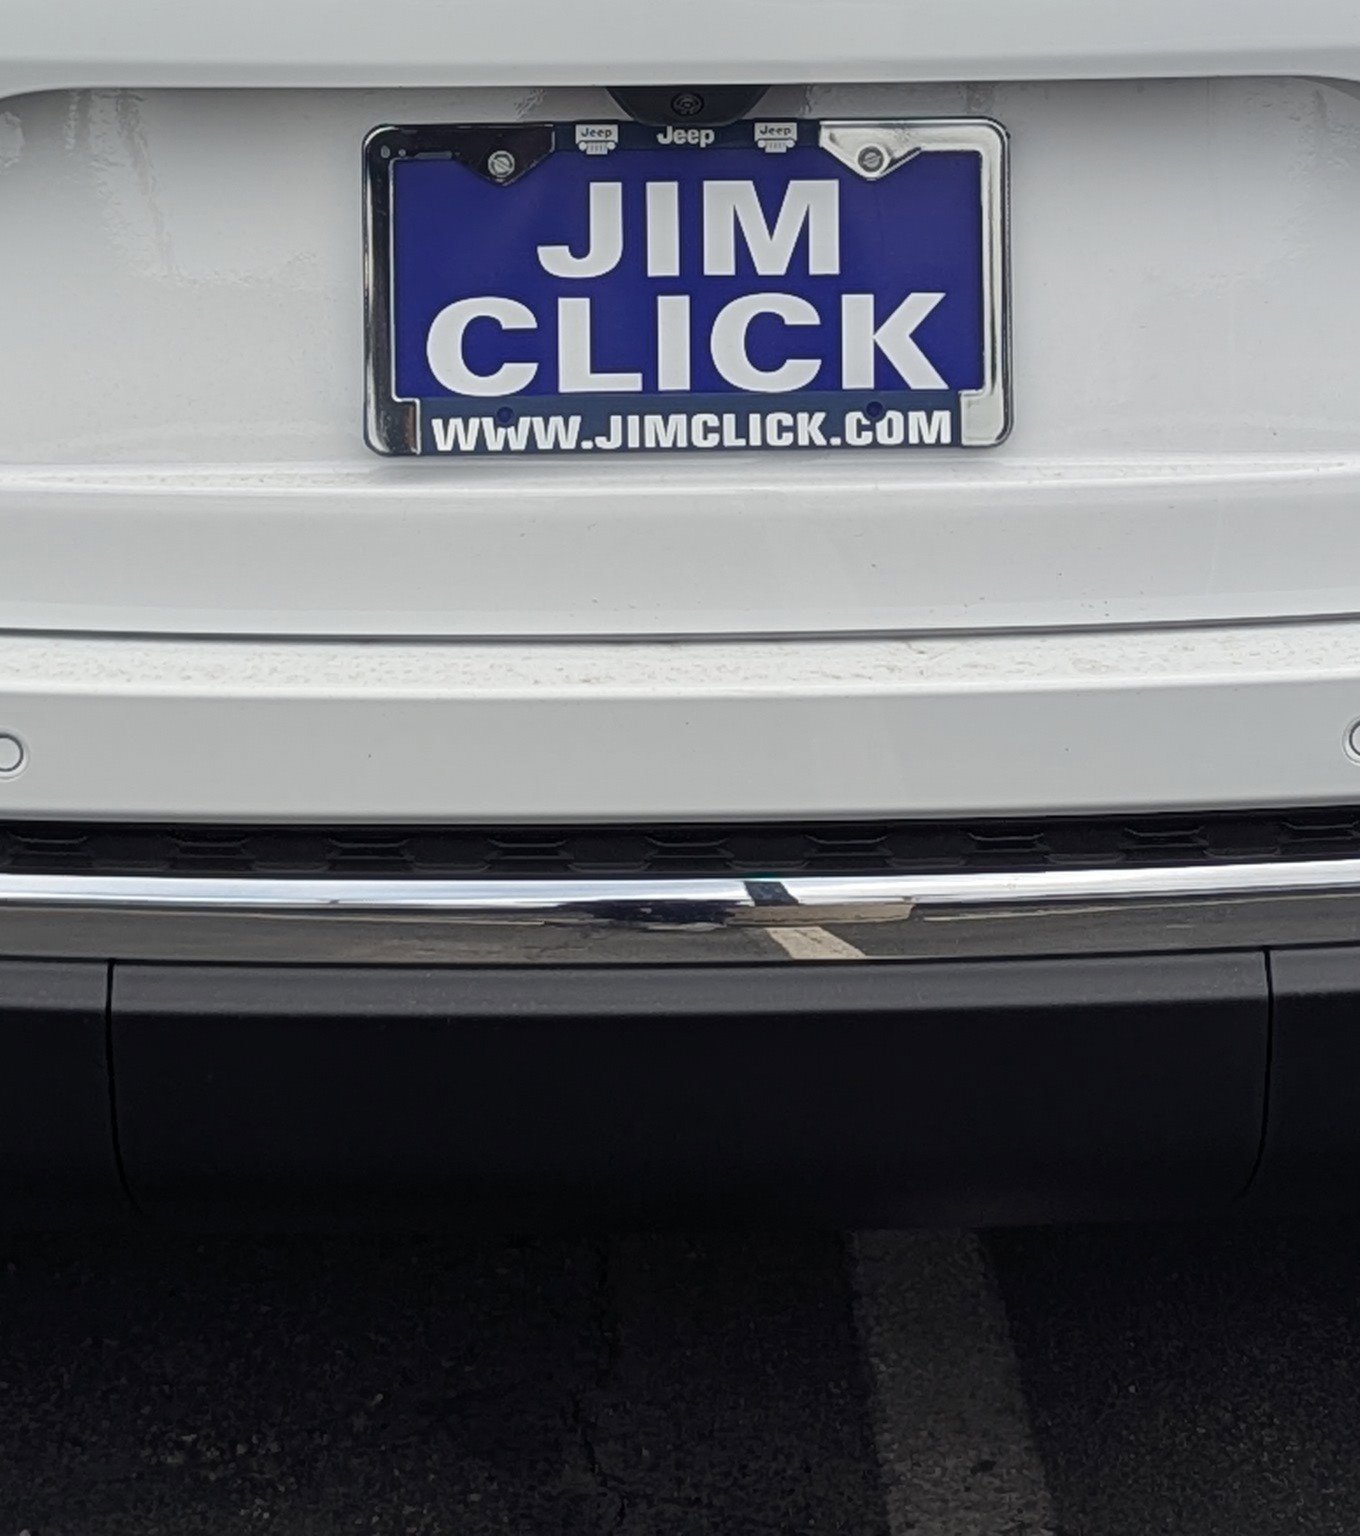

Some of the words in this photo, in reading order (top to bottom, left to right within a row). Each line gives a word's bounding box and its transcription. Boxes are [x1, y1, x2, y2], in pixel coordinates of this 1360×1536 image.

[581, 127, 612, 138] Jeep
[657, 125, 715, 147] Jeep
[760, 125, 792, 136] Jeep
[537, 179, 840, 278] JIM
[426, 292, 949, 397] CLICK
[431, 410, 952, 452] WWW.JIMCLICK.COM
